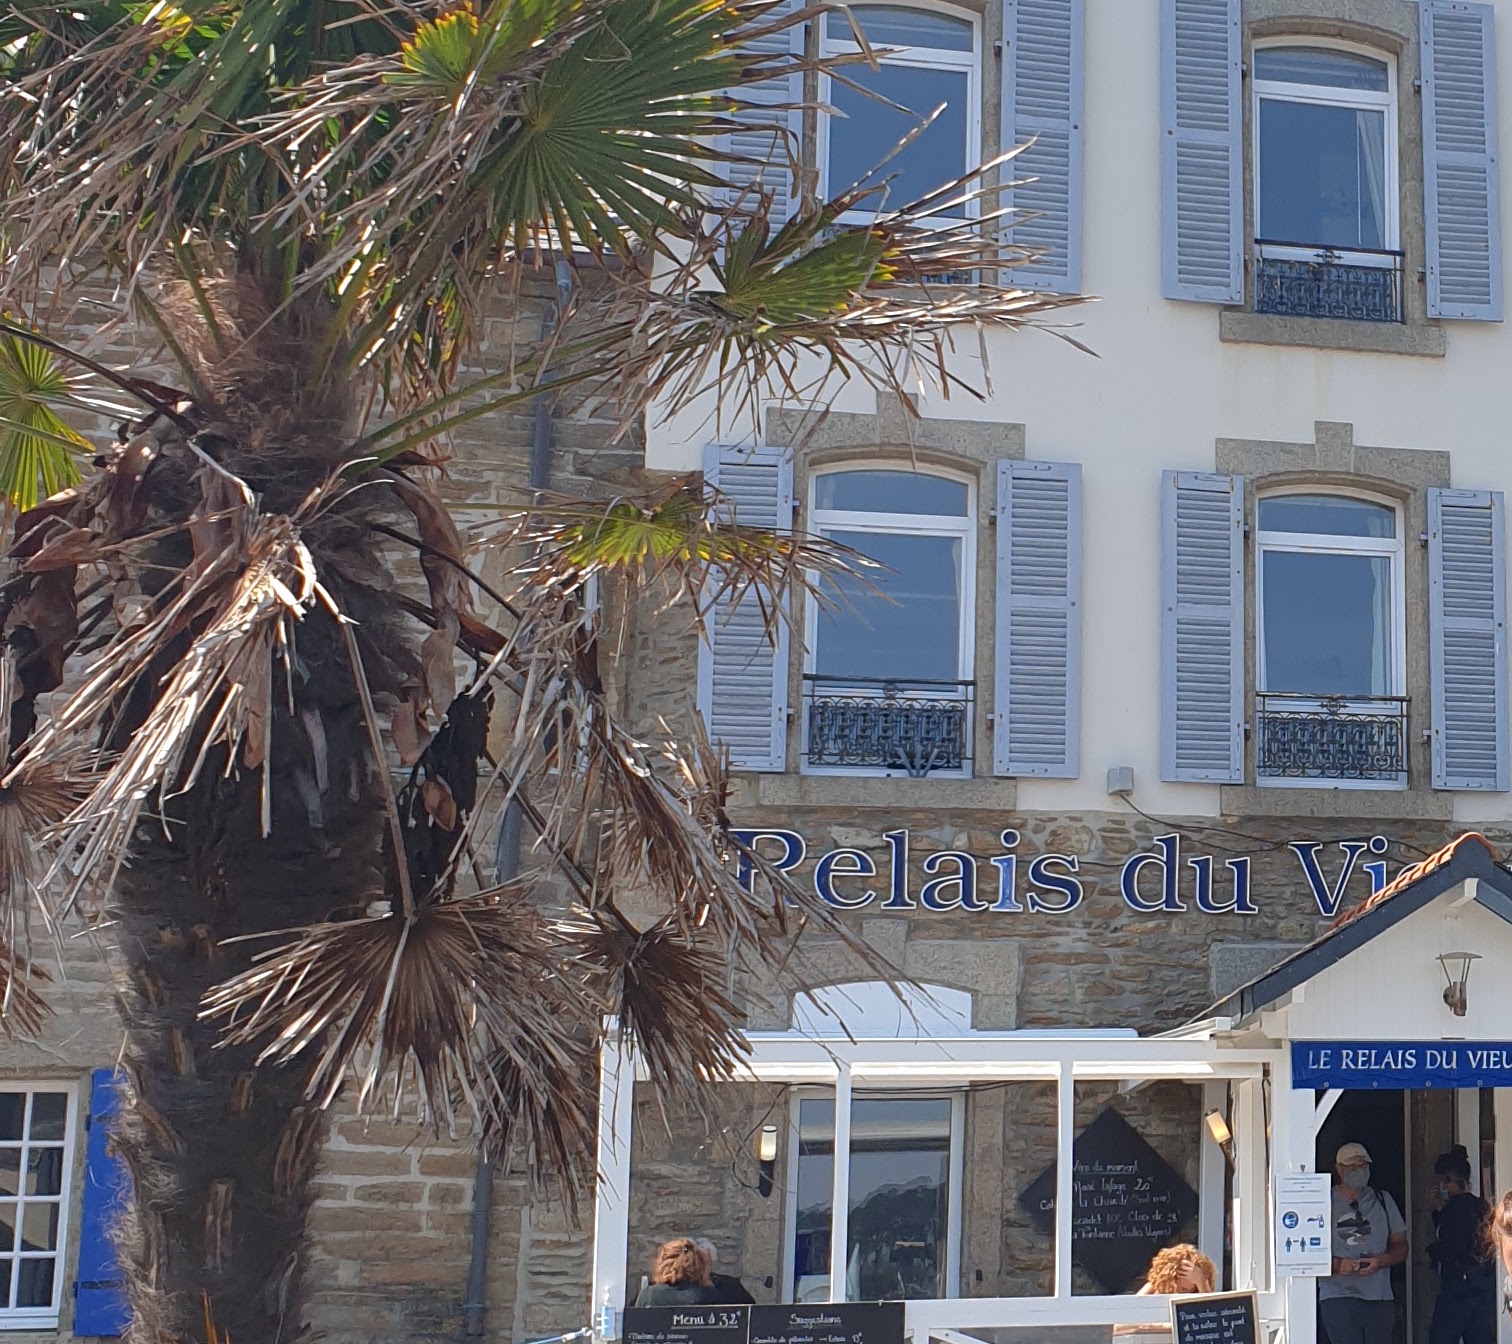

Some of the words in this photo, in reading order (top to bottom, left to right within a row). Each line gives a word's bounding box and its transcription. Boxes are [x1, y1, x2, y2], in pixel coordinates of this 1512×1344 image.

[727, 829, 1084, 913] Relais
[1120, 833, 1258, 914] du
[1309, 1050, 1331, 1069] LE
[1341, 1049, 1417, 1070] RELAIS
[1425, 1050, 1457, 1069] DU
[673, 1314, 705, 1325] Menu
